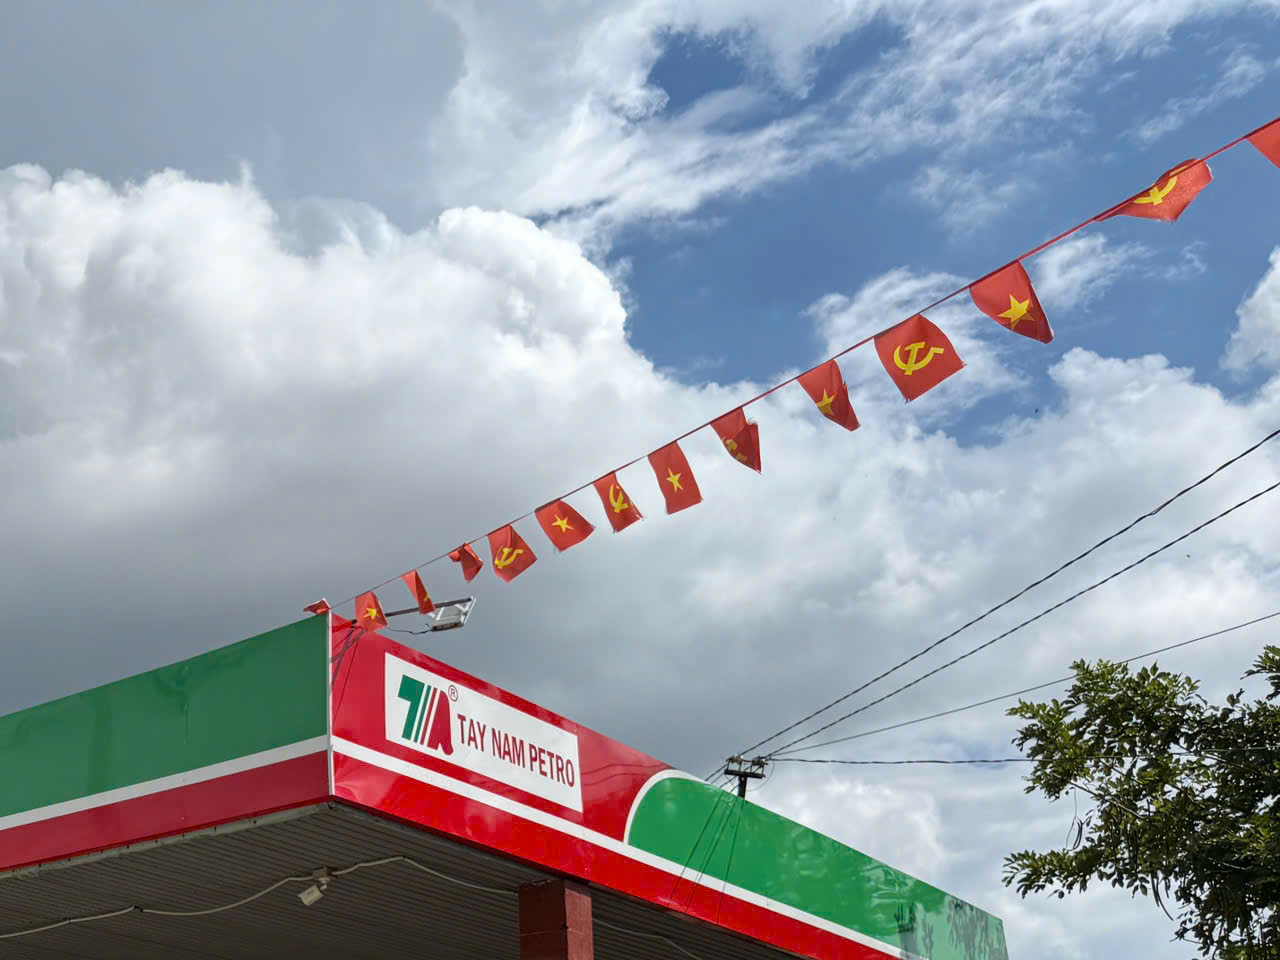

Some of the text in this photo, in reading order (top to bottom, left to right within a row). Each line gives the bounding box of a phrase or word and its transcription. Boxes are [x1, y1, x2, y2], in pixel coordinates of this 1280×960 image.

[457, 713, 575, 787] TAY NAM PETRO
